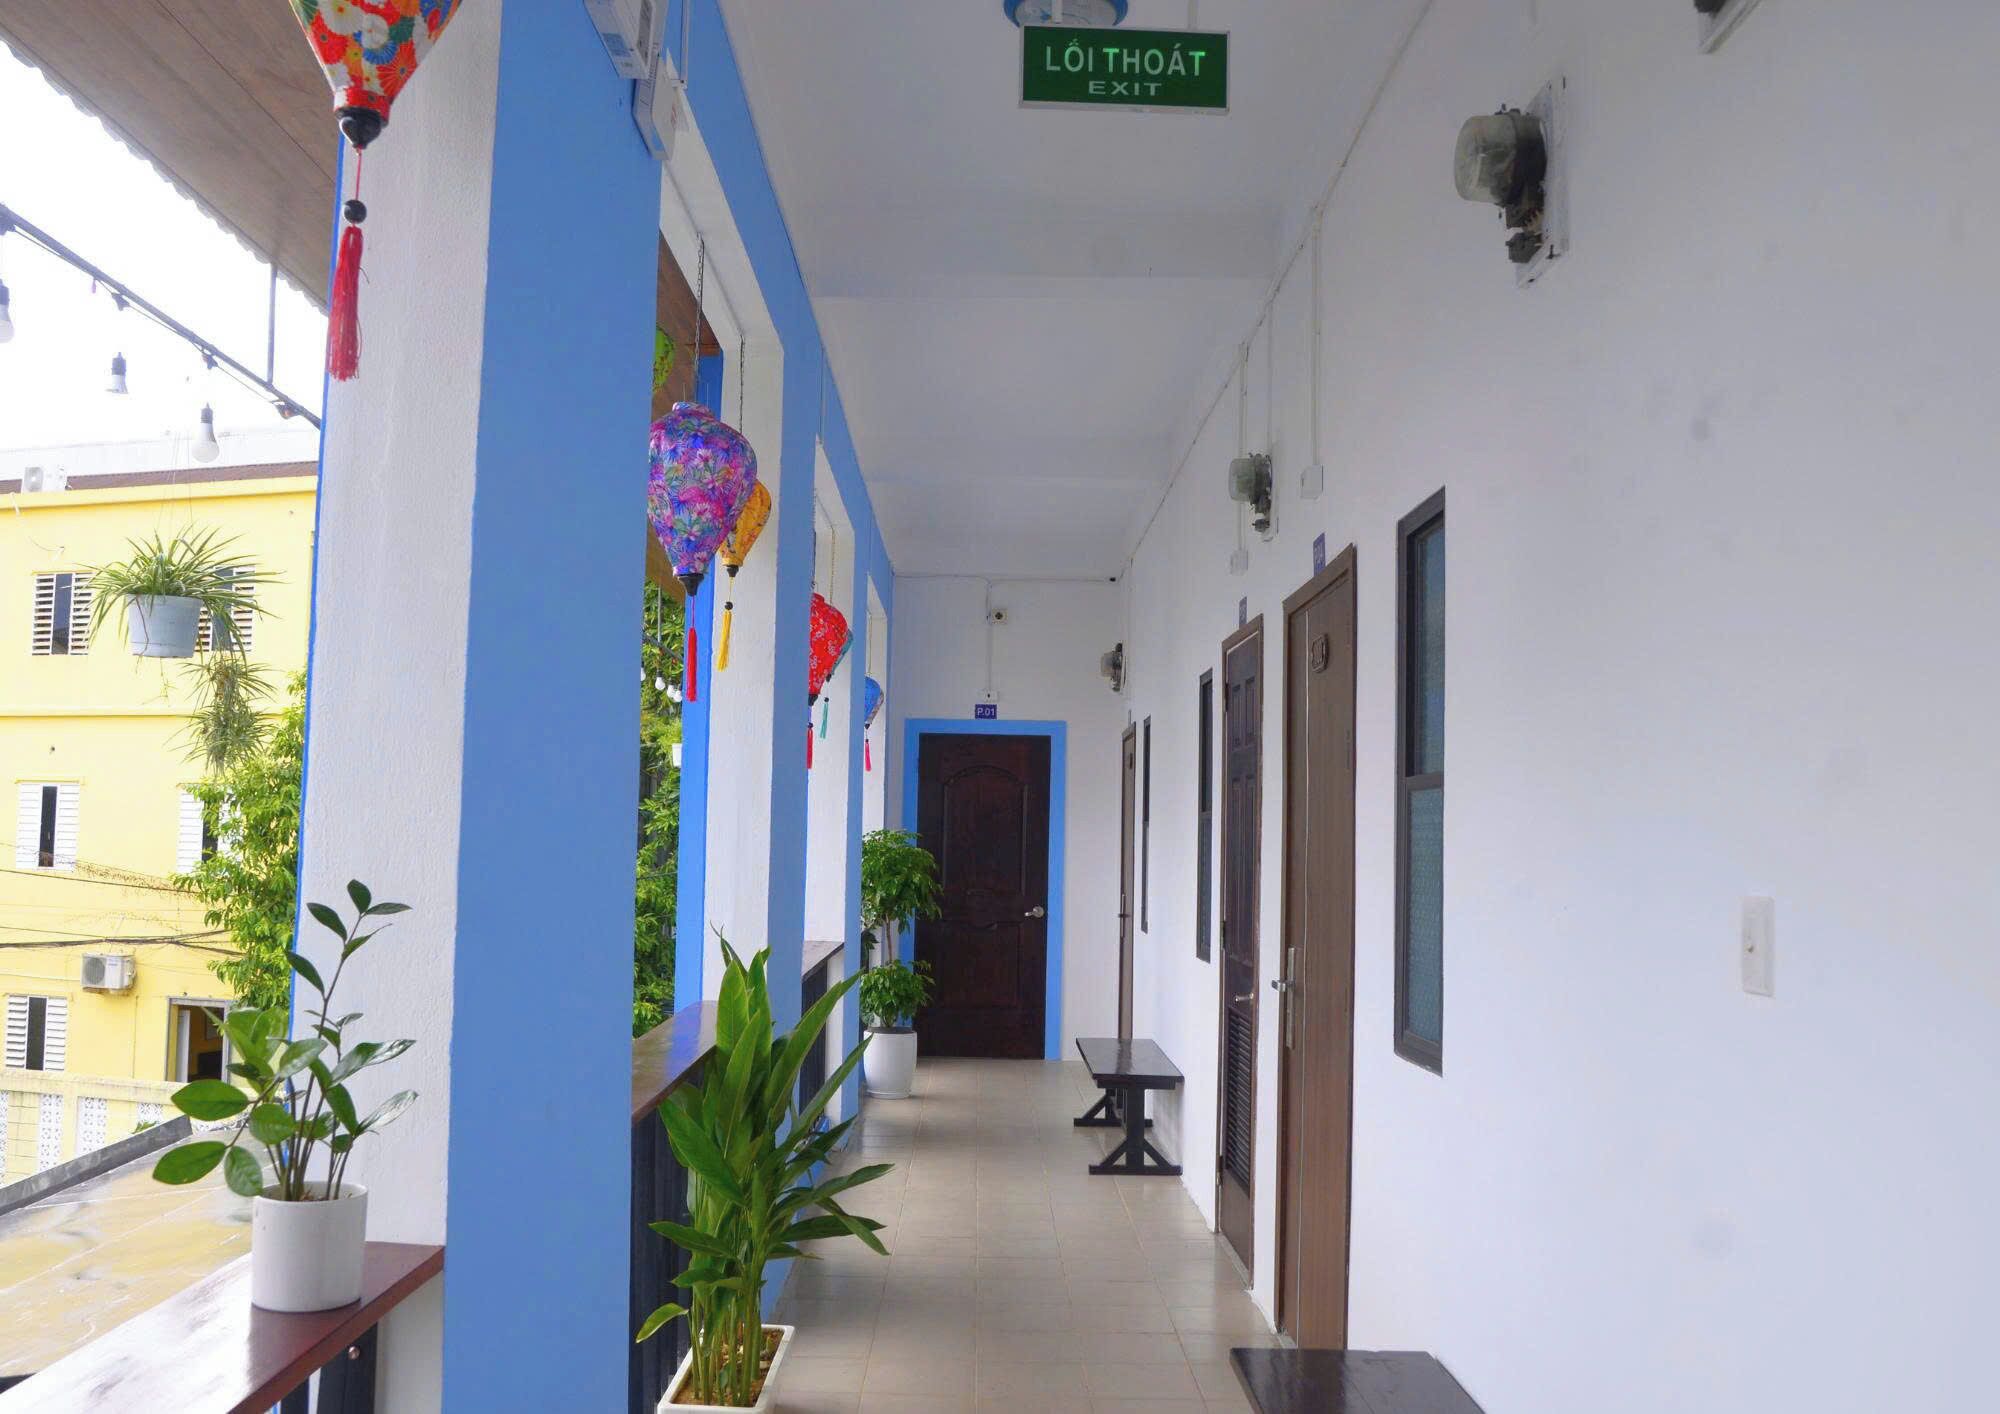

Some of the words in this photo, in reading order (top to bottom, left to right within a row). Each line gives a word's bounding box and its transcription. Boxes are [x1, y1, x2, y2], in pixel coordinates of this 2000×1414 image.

[1046, 38, 1093, 73] LỐI
[1102, 43, 1206, 77] THOÁT
[1088, 80, 1162, 96] EXIT
